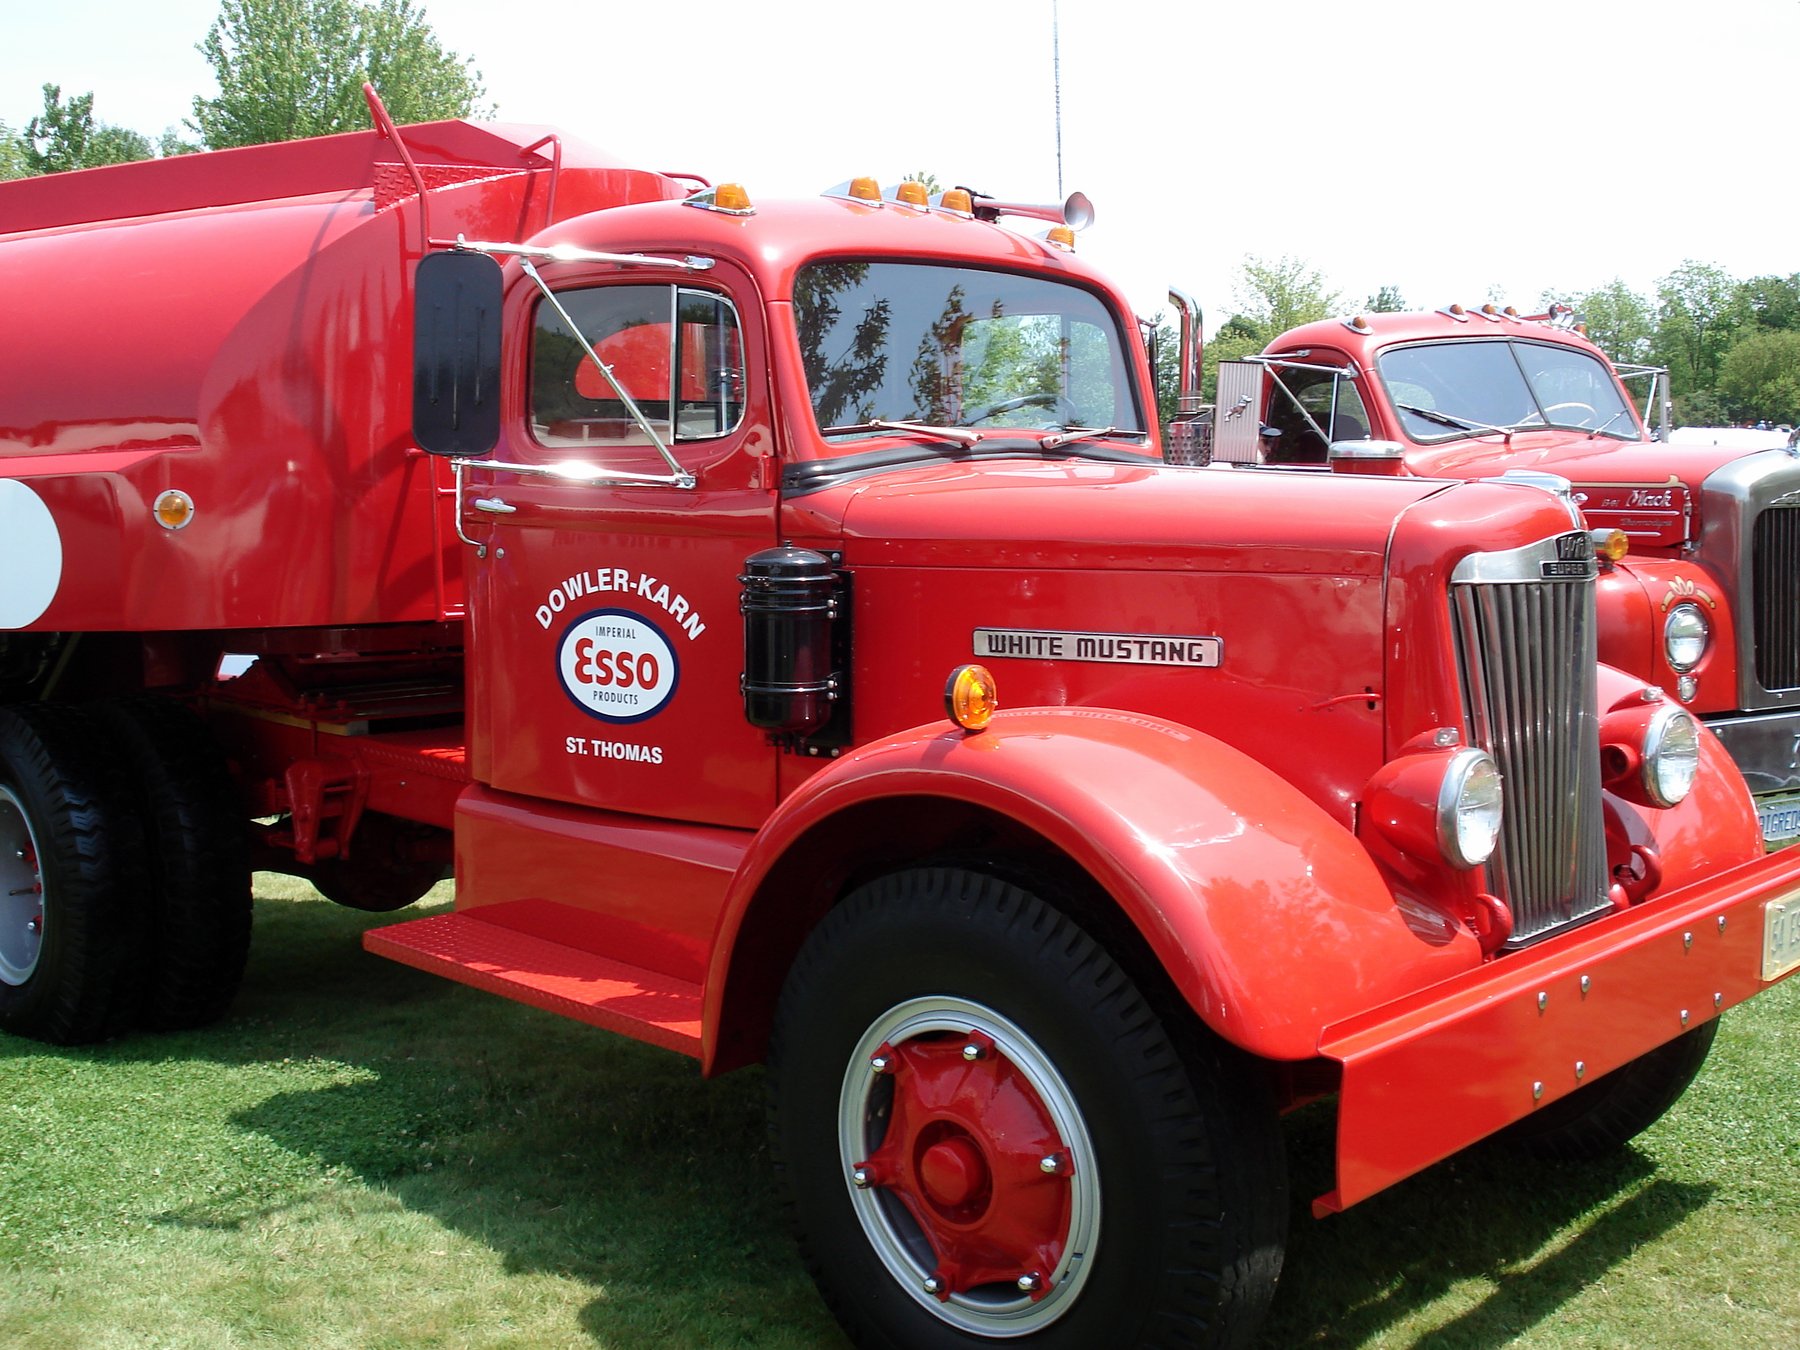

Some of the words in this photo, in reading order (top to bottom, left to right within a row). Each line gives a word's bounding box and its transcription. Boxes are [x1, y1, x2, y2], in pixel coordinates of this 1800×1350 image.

[1625, 489, 1672, 507] Mack
[1550, 563, 1584, 575] SUPER
[535, 567, 706, 641] DOWLER-KARN
[595, 626, 636, 640] IMPERIAL
[987, 634, 1062, 656] WHITE
[1077, 638, 1203, 663] MUSTANG
[593, 690, 639, 705] PRODUCTS
[565, 736, 588, 755] ST.
[591, 739, 664, 764] THOMAS
